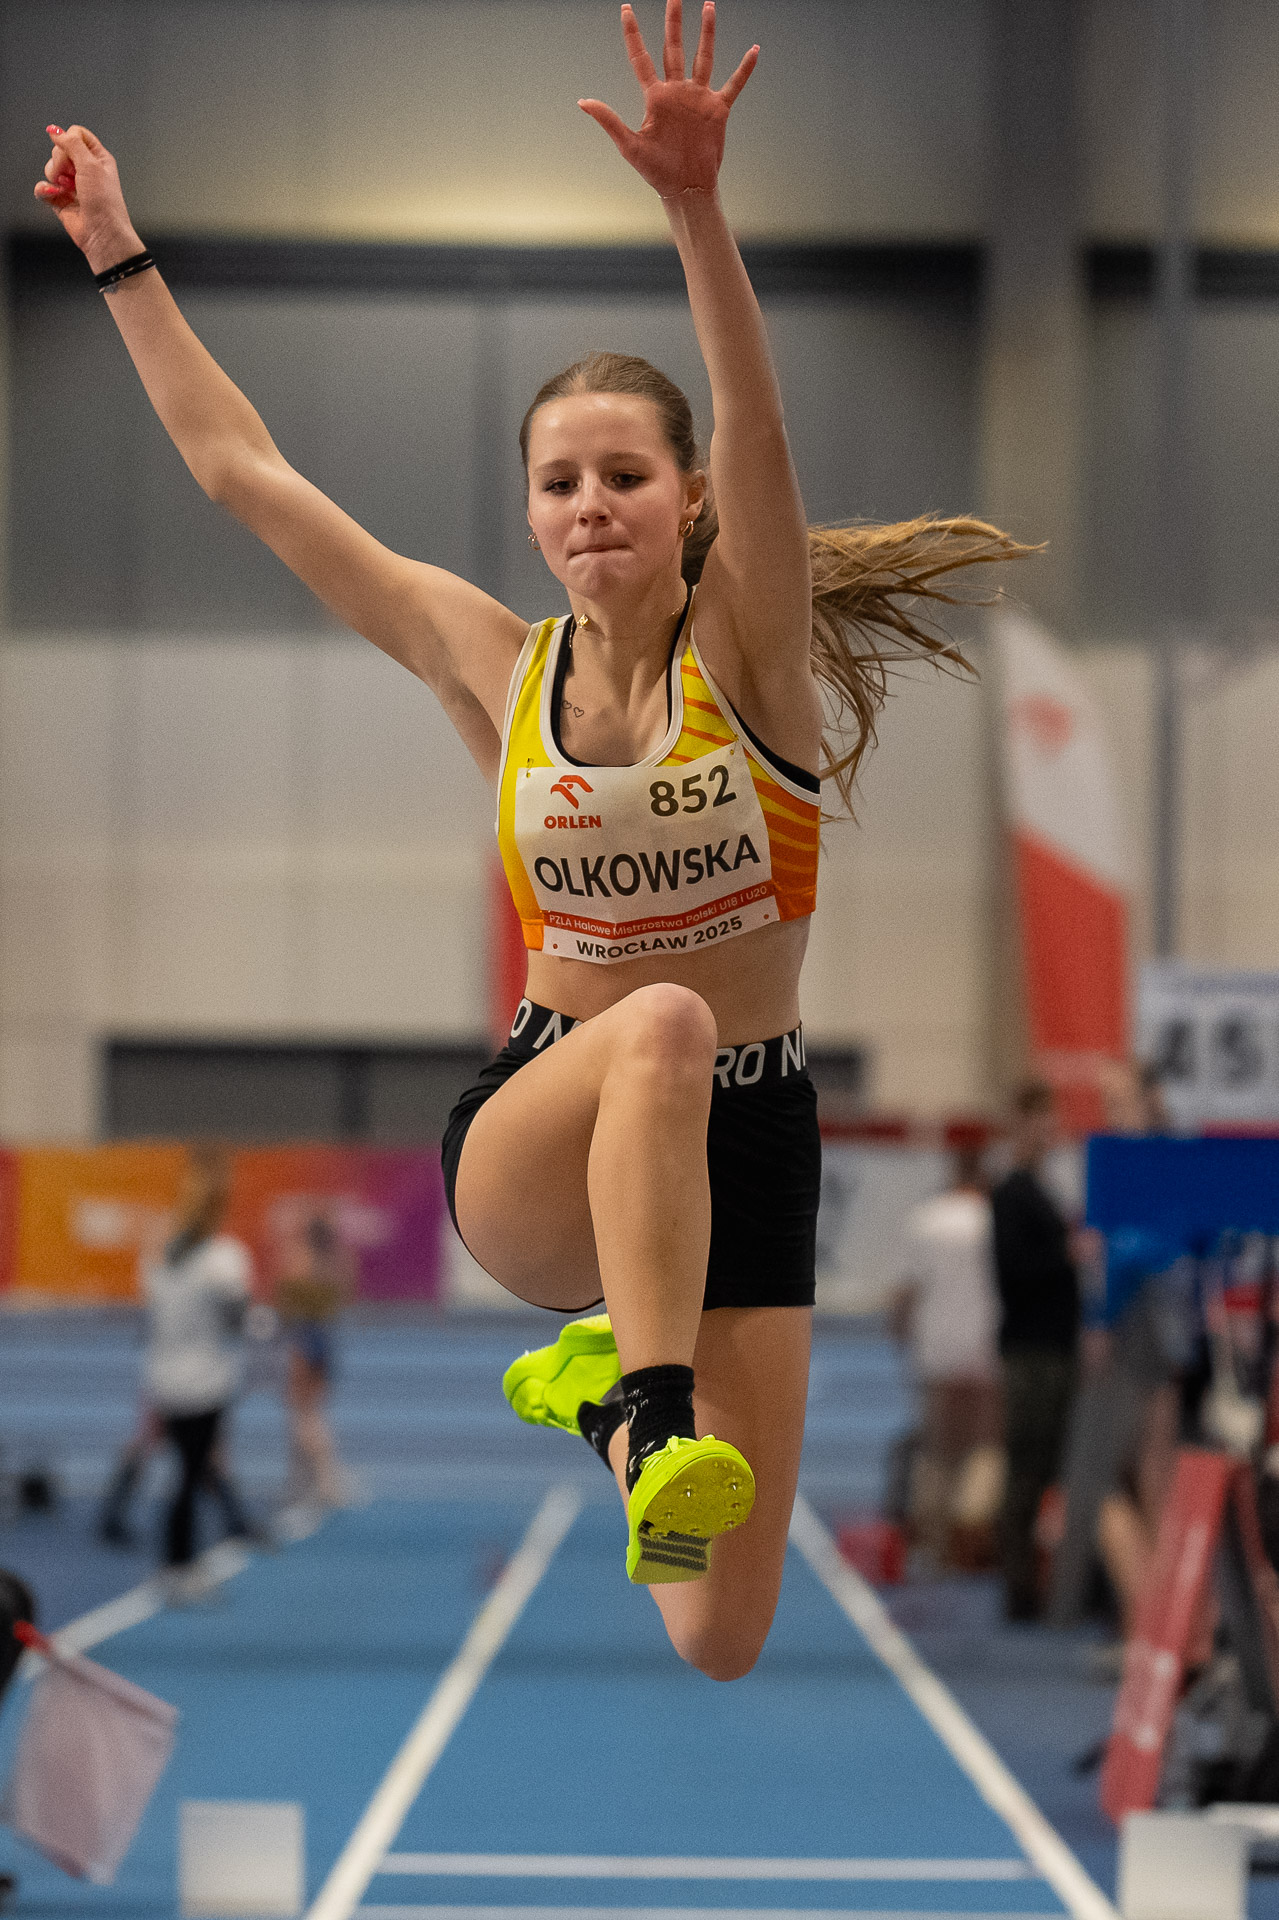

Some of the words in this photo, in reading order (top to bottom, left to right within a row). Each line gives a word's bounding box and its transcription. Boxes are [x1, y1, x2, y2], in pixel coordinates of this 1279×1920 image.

[649, 764, 737, 817] 852
[543, 815, 602, 829] ORLEN
[534, 834, 761, 898] OLKOWSKA
[549, 914, 572, 927] PZLA
[574, 918, 611, 936] Halowe
[613, 918, 684, 936] Mistrzostwa
[686, 903, 718, 924] Polski
[719, 896, 738, 911] U18
[745, 885, 768, 900] U20
[576, 934, 688, 959] WROCŁAW
[693, 915, 743, 945] 2025
